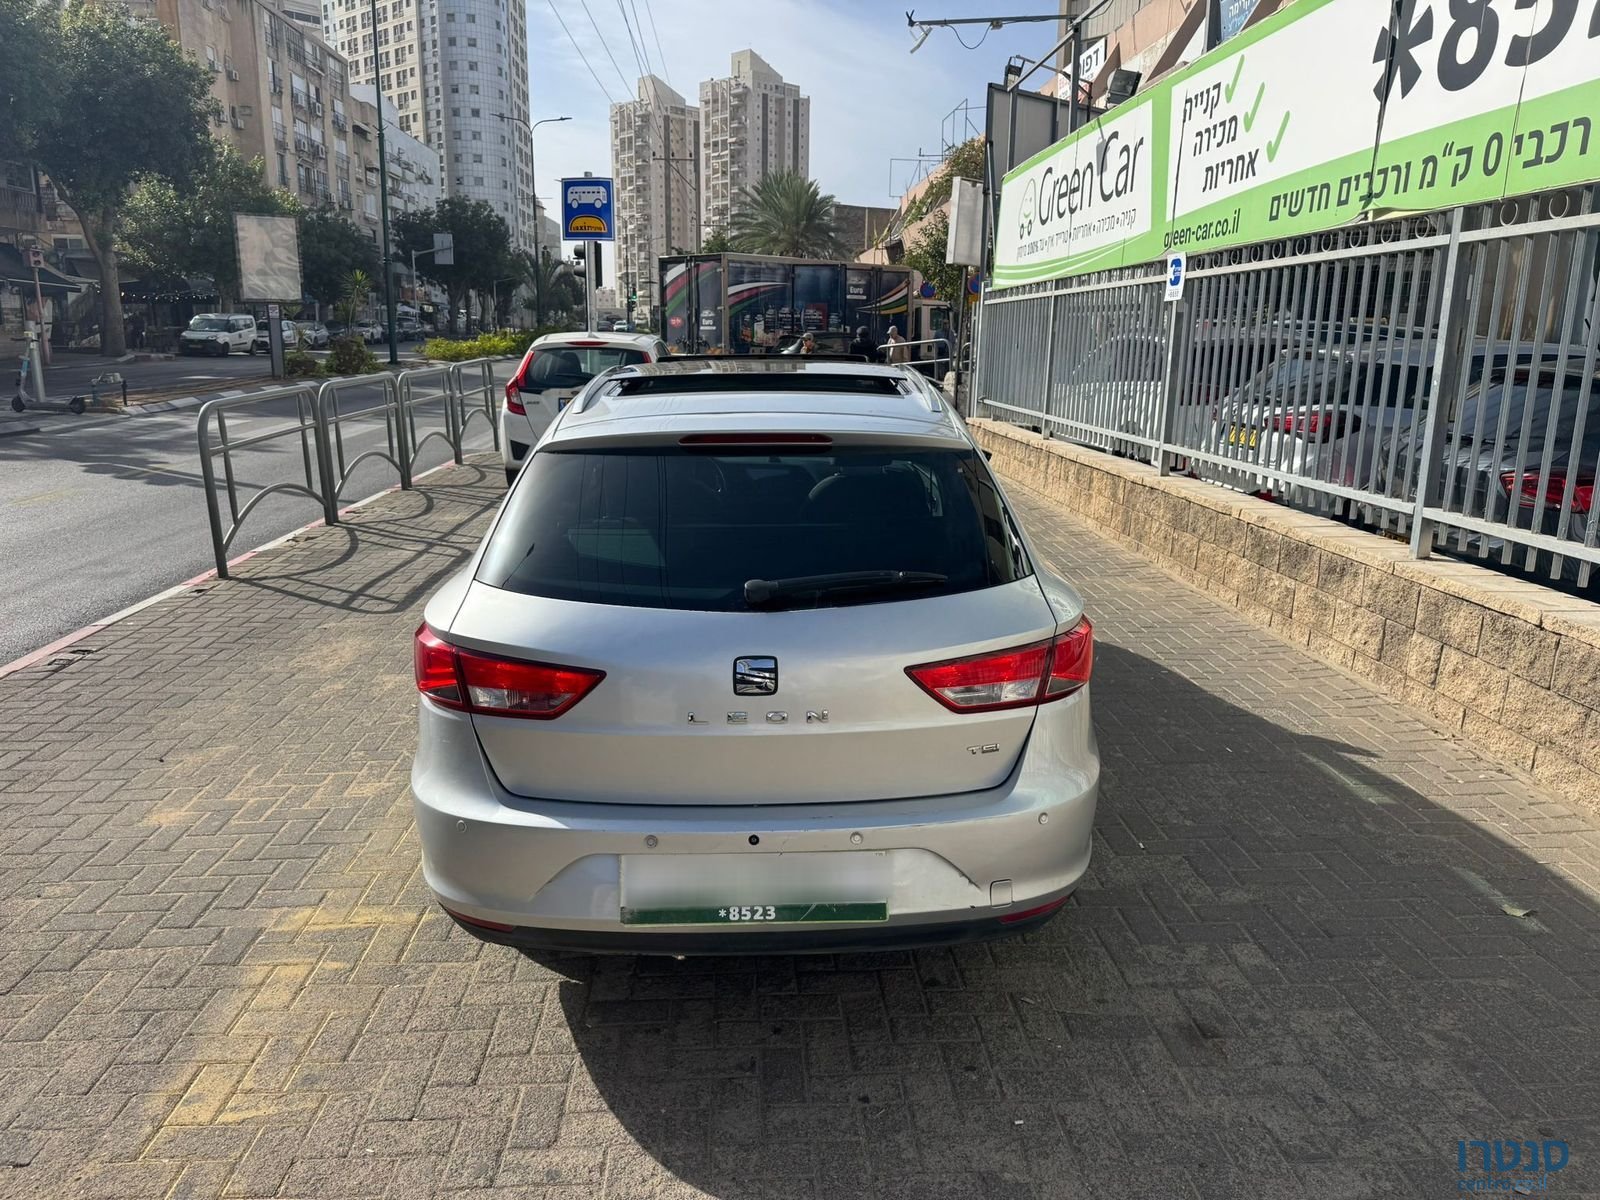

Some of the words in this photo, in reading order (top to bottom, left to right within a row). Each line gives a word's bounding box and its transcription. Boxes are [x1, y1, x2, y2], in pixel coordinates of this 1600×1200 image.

[1079, 47, 1100, 76] דפו
[1183, 82, 1221, 123] קניית
[1193, 115, 1238, 157] מכירה
[1482, 131, 1504, 177] 0
[1514, 116, 1592, 169] רכבי
[1038, 161, 1094, 226] Green
[1099, 130, 1144, 203] Car
[1202, 148, 1259, 193] אחריות
[1336, 161, 1412, 209] ורכבים
[1268, 182, 1331, 222] חדשים
[849, 286, 864, 294] Euro
[702, 318, 714, 326] Euro
[688, 709, 829, 725] LEON
